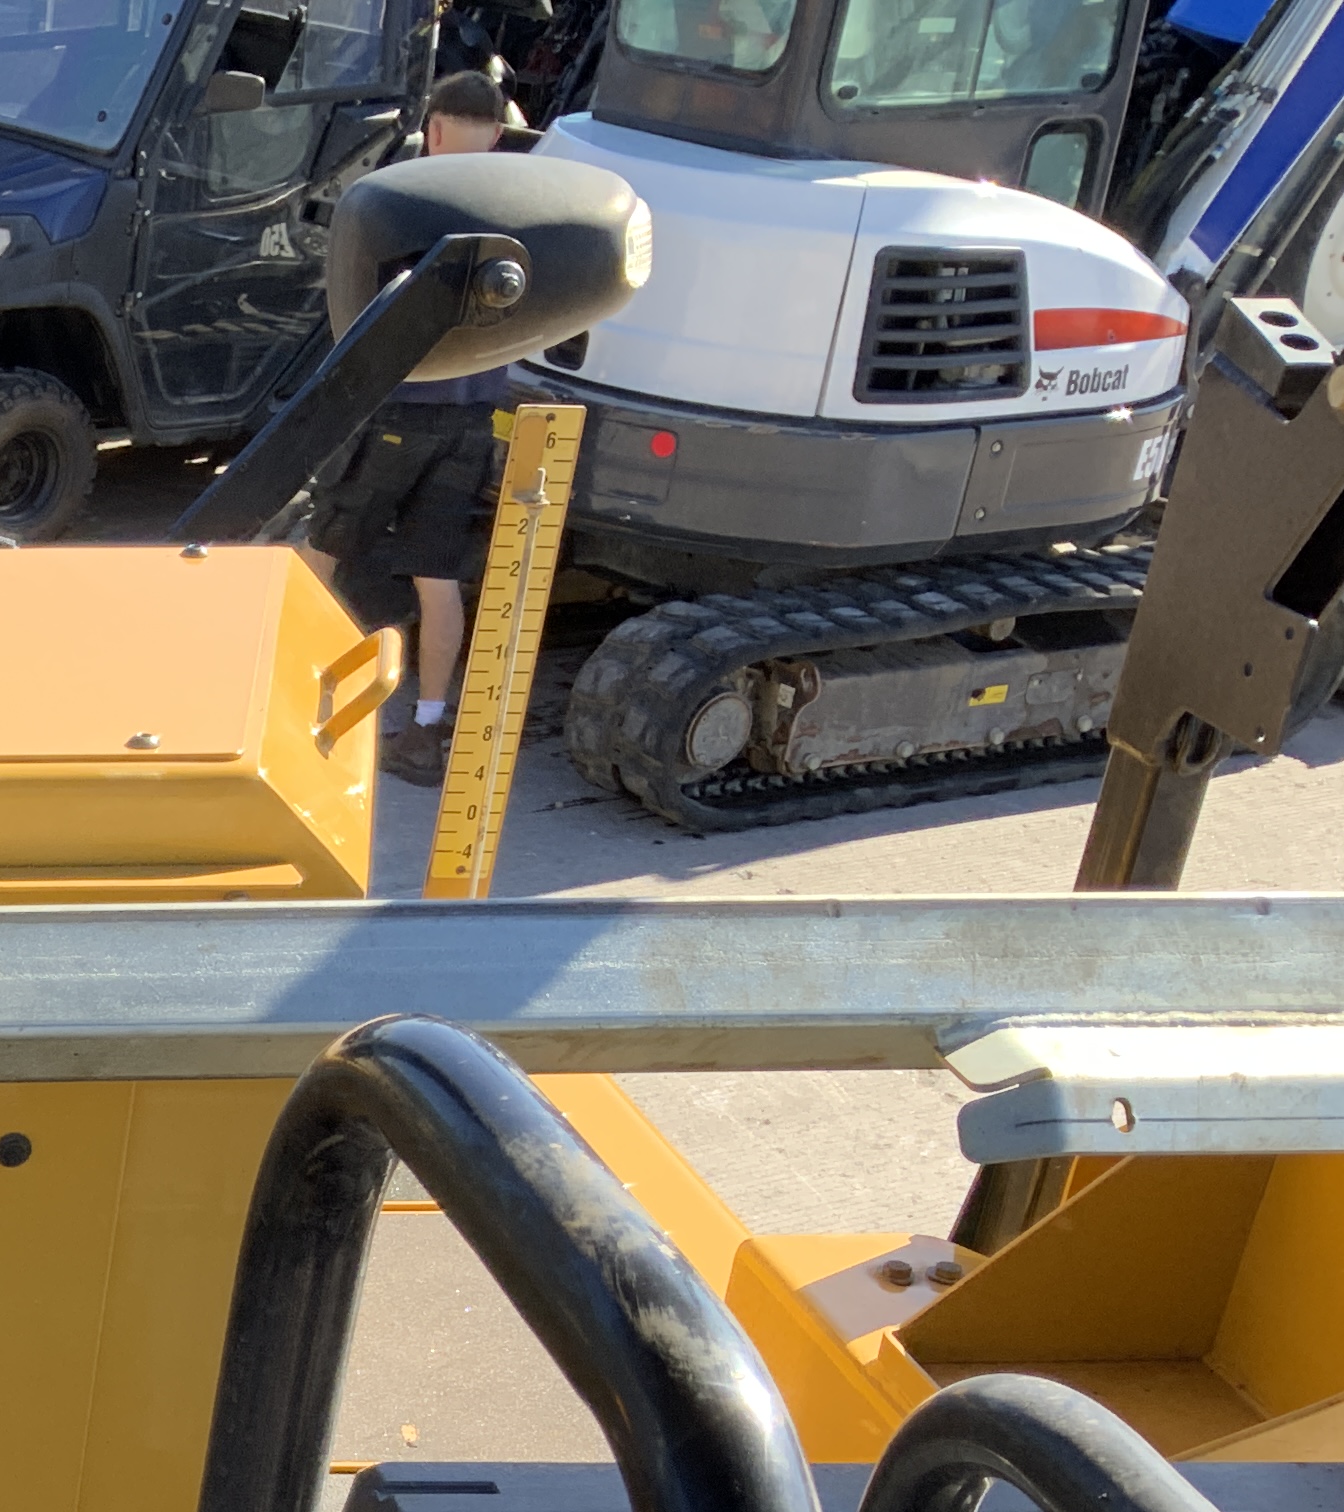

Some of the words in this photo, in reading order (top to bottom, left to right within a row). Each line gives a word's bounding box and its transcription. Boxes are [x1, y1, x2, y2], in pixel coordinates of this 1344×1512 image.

[1065, 363, 1130, 396] Bobcat
[482, 725, 493, 742] 8
[474, 765, 485, 781] 4
[466, 804, 477, 821] 0
[455, 843, 472, 859] -4
